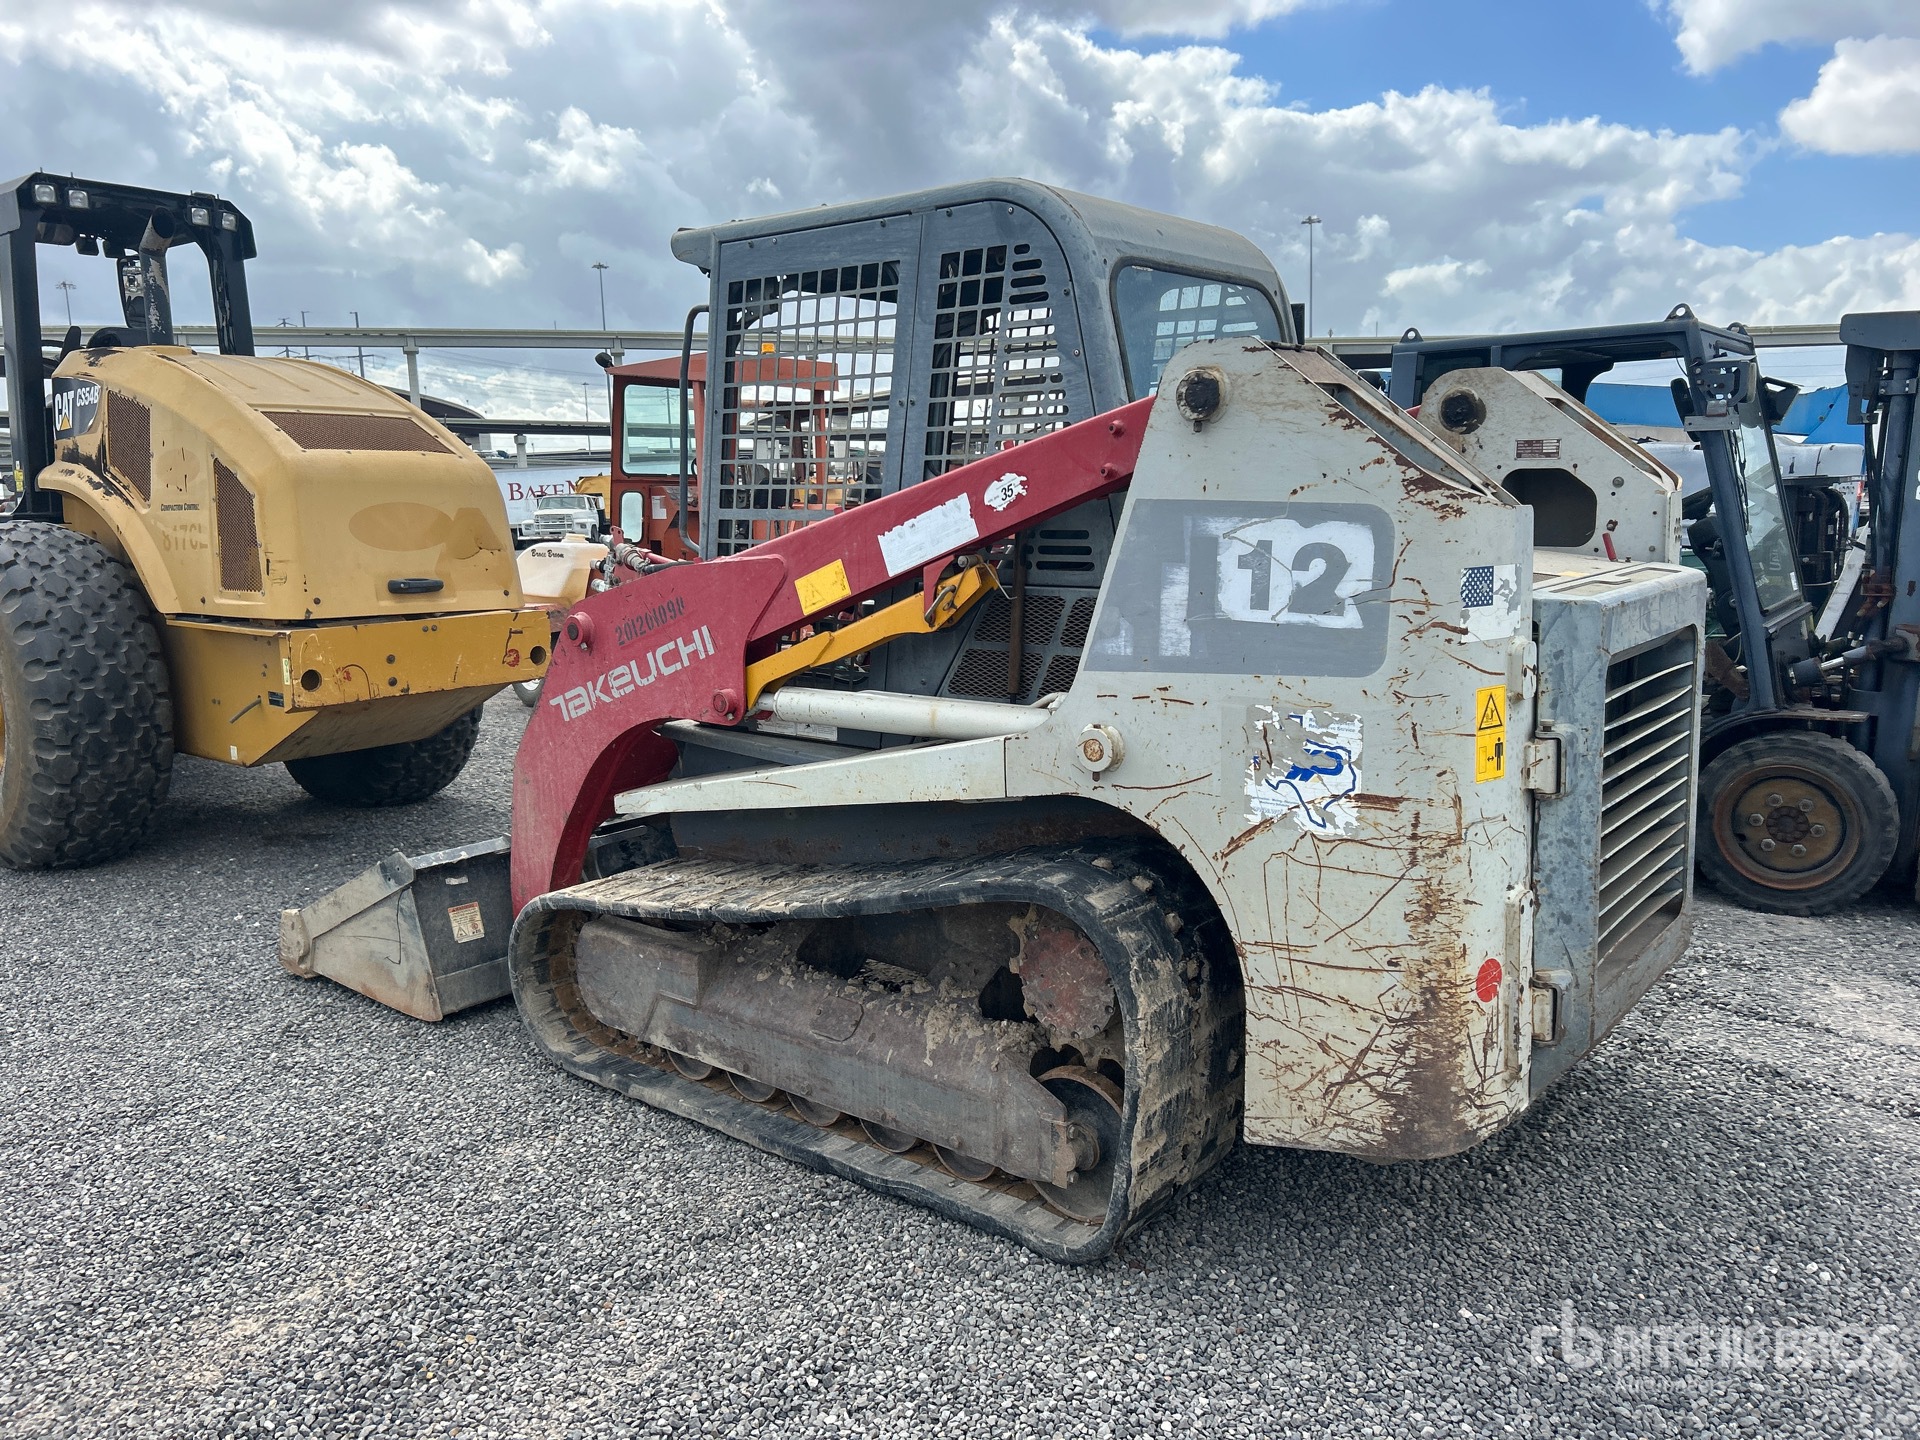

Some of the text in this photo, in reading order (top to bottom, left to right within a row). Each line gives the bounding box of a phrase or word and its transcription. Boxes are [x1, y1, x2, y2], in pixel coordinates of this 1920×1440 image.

[55, 386, 99, 431] CAT CS54B
[1001, 483, 1014, 501] 35
[549, 625, 715, 722] TAKEUCHI
